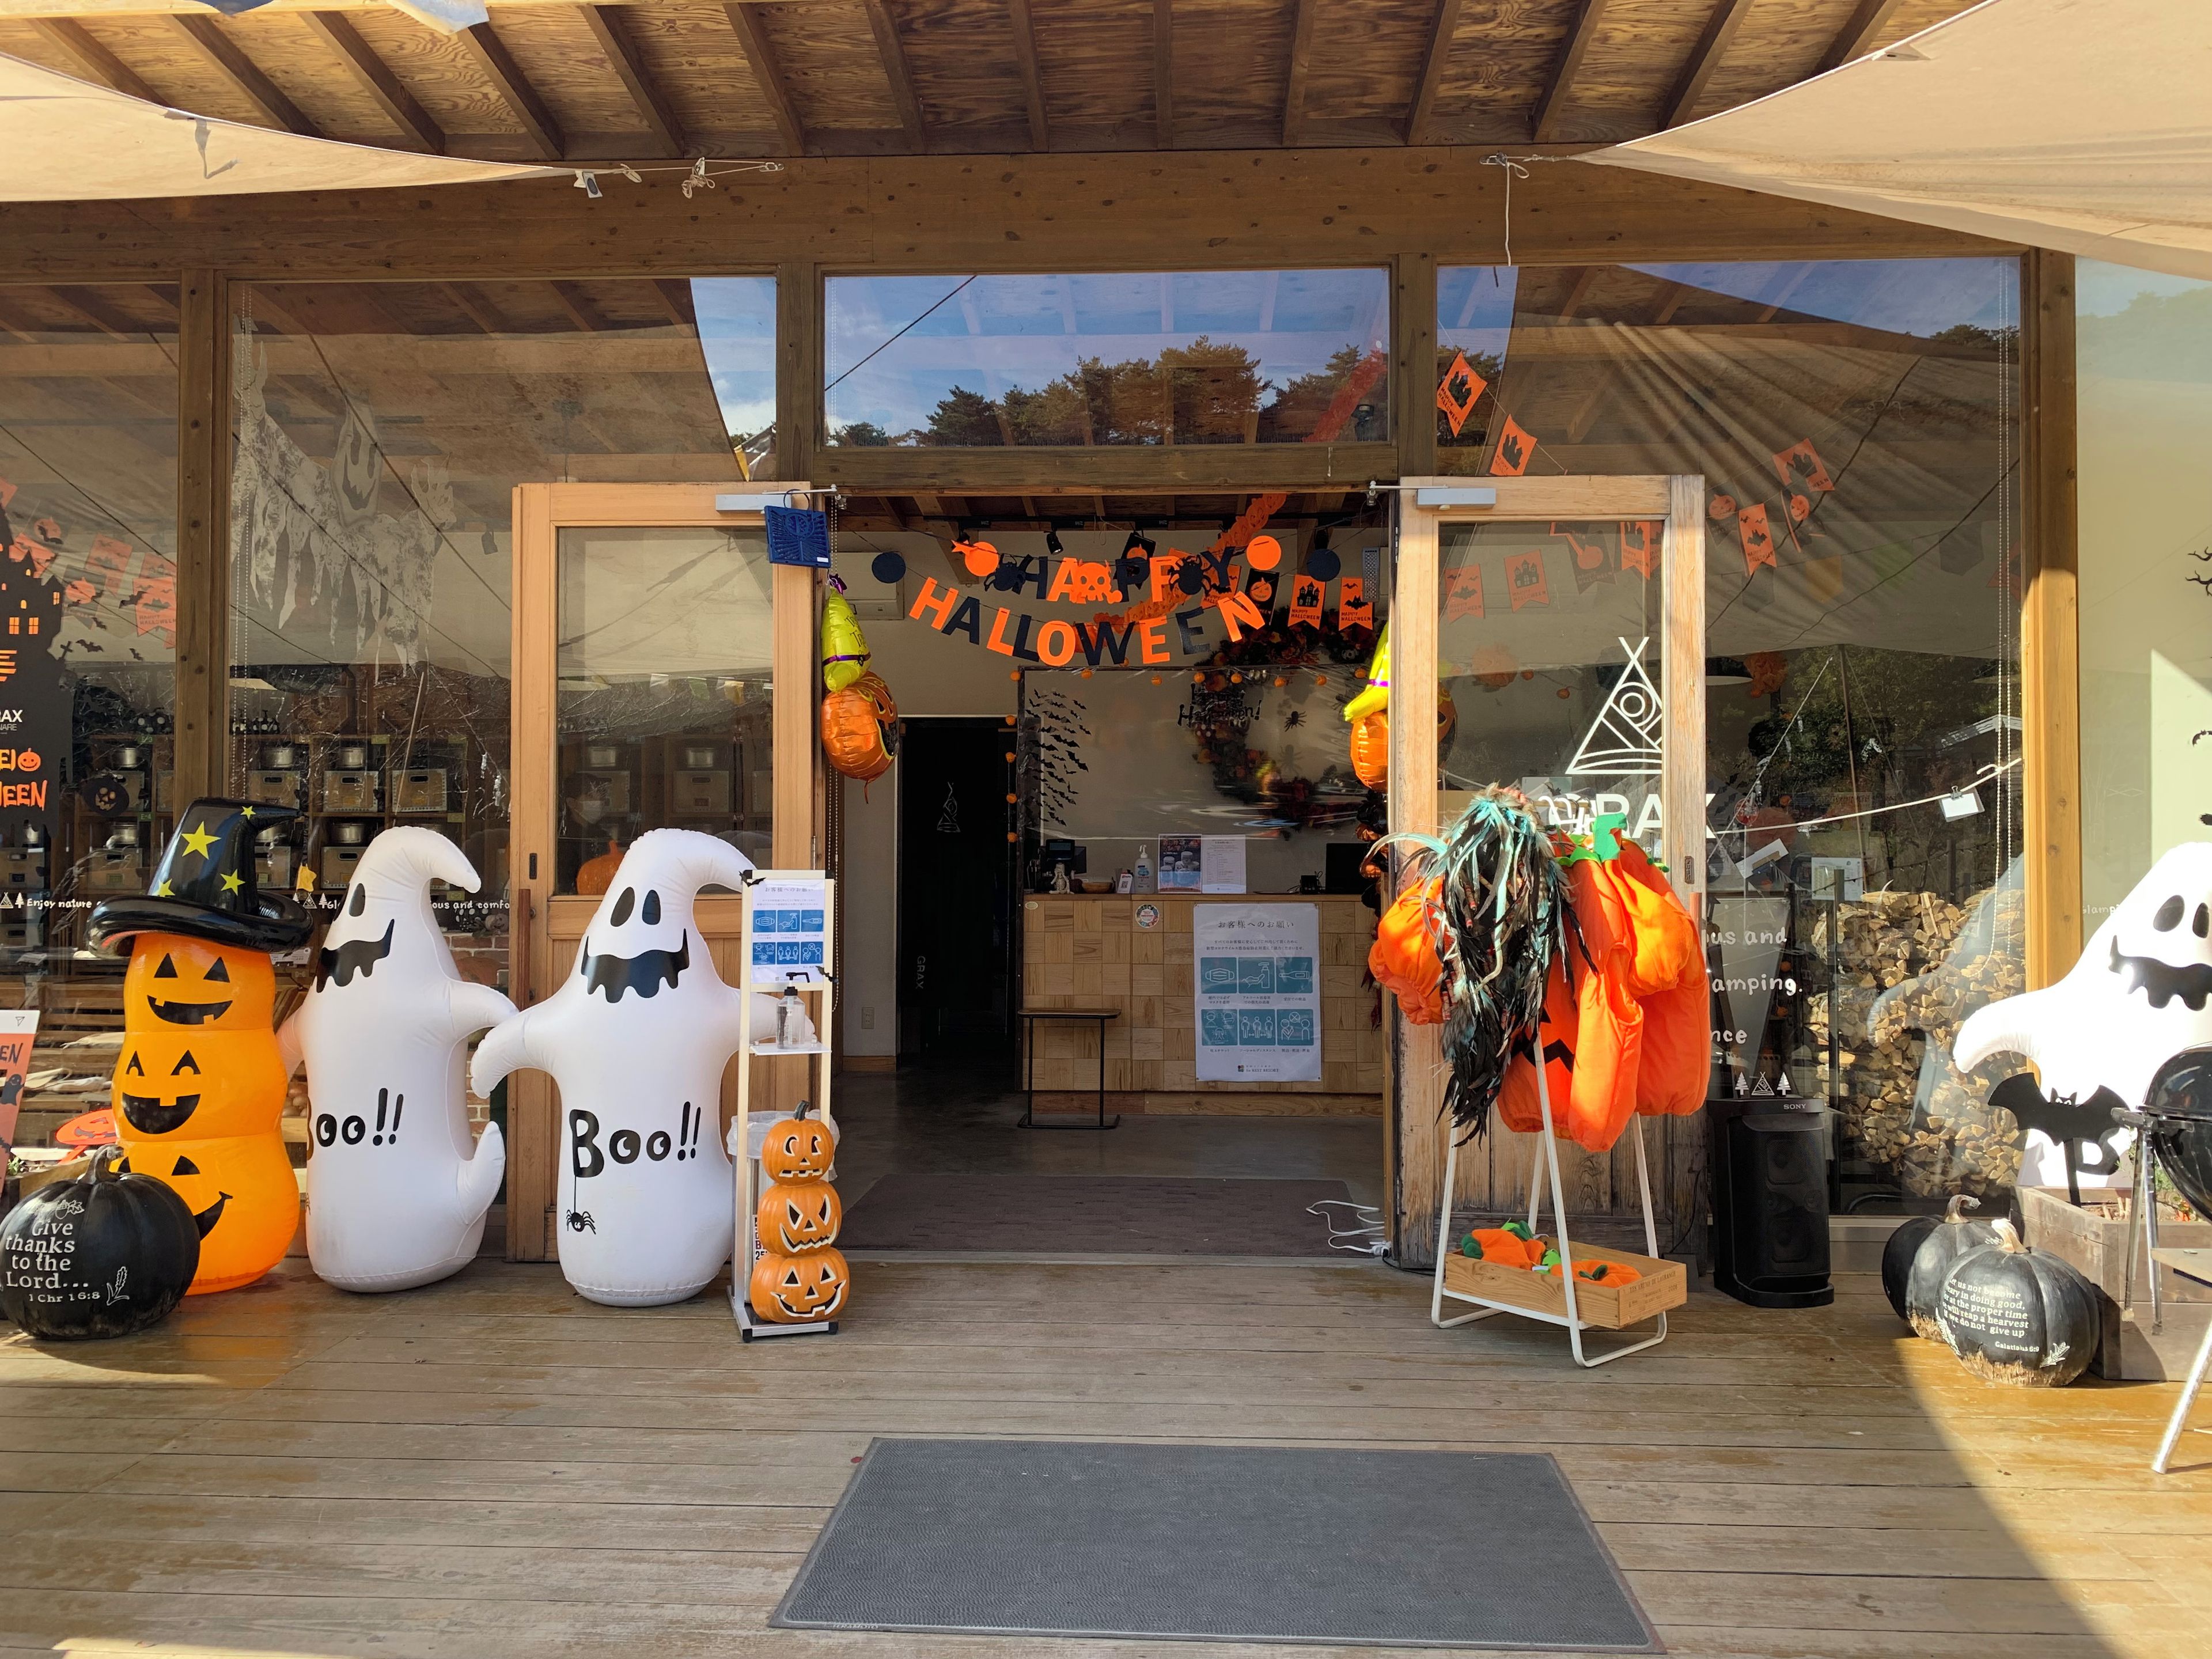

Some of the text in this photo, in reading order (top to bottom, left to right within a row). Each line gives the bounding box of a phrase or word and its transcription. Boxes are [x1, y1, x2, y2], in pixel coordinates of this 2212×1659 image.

[910, 577, 1266, 666] HALLOWEEN
[0, 710, 22, 722] AX
[0, 749, 16, 771] EI
[0, 780, 47, 811] EEN
[27, 899, 92, 910] Enjoy nature
[453, 900, 473, 909] and
[478, 899, 510, 909] comfo
[1218, 920, 1294, 929] お客様へのお願い
[1707, 927, 1787, 946] us and
[916, 956, 926, 989] GRAX
[1712, 974, 1802, 996] amping.
[1711, 1029, 1747, 1044] nce
[0, 1043, 24, 1066] EN
[309, 1088, 404, 1158] oo!!
[569, 1101, 701, 1178] Boo!!
[32, 1219, 73, 1236] Give
[5, 1234, 75, 1253] thanks
[12, 1252, 71, 1271] to the
[6, 1271, 89, 1289] Lord...
[1958, 1280, 1966, 1289] us
[1968, 1283, 1982, 1293] not
[37, 1294, 63, 1302] Chr
[1961, 1292, 1969, 1300] in
[1971, 1294, 1995, 1307] doing
[1998, 1300, 2025, 1310] good,
[1949, 1297, 1956, 1305] at
[1957, 1299, 1969, 1309] the
[1971, 1305, 2003, 1318] proper
[2005, 1310, 2028, 1320] time
[1949, 1314, 1959, 1324] we
[1960, 1317, 1969, 1327] do
[1971, 1321, 1986, 1331] not
[1990, 1326, 2009, 1336] give
[2012, 1330, 2025, 1339] up
[1961, 1309, 1978, 1323] reap
[1988, 1316, 2029, 1329] hearvest
